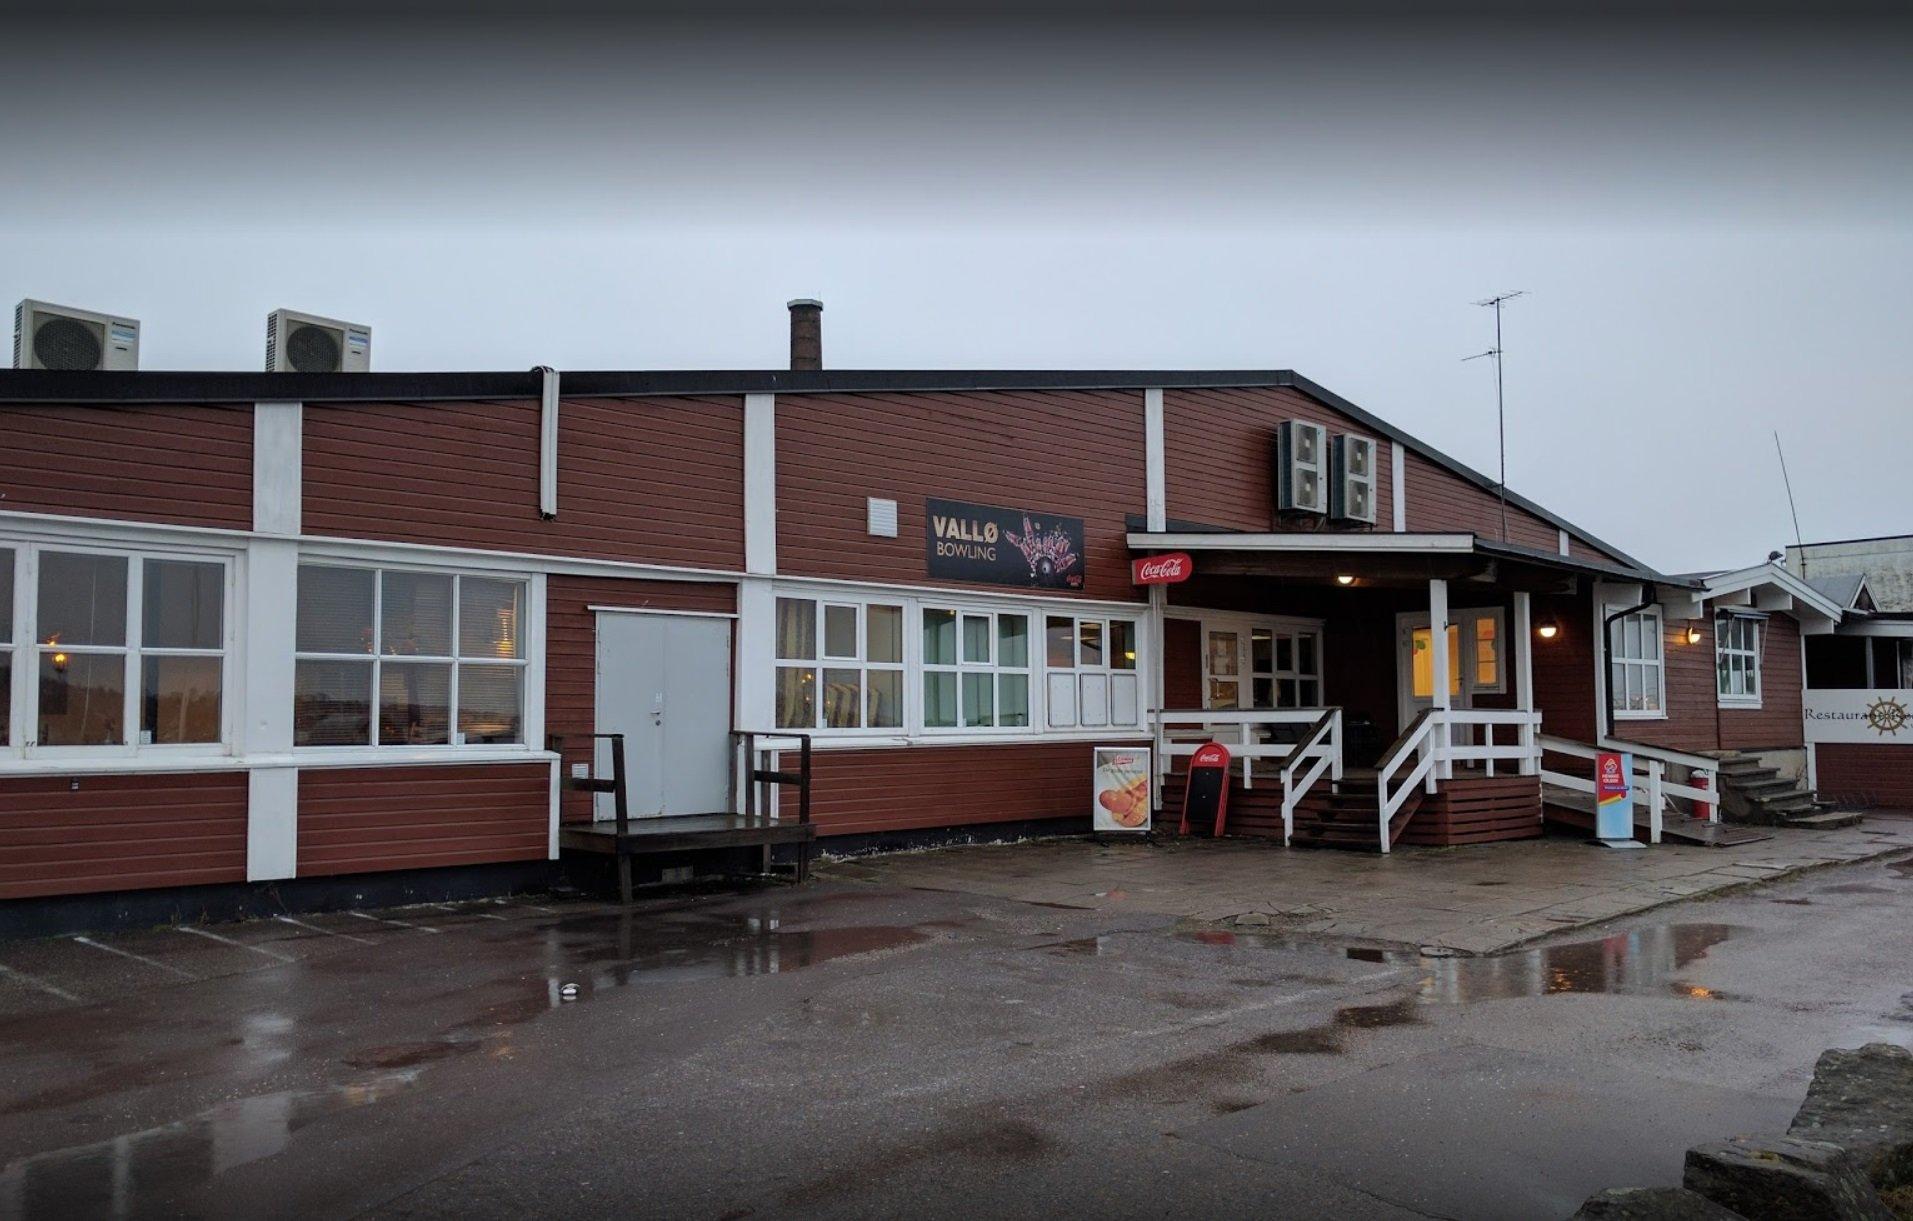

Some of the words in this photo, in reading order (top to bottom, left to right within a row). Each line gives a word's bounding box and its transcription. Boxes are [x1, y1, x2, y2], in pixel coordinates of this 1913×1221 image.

[933, 515, 998, 544] VALLØ
[937, 541, 997, 561] BOWLING
[1805, 708, 1885, 721] Restaurat
